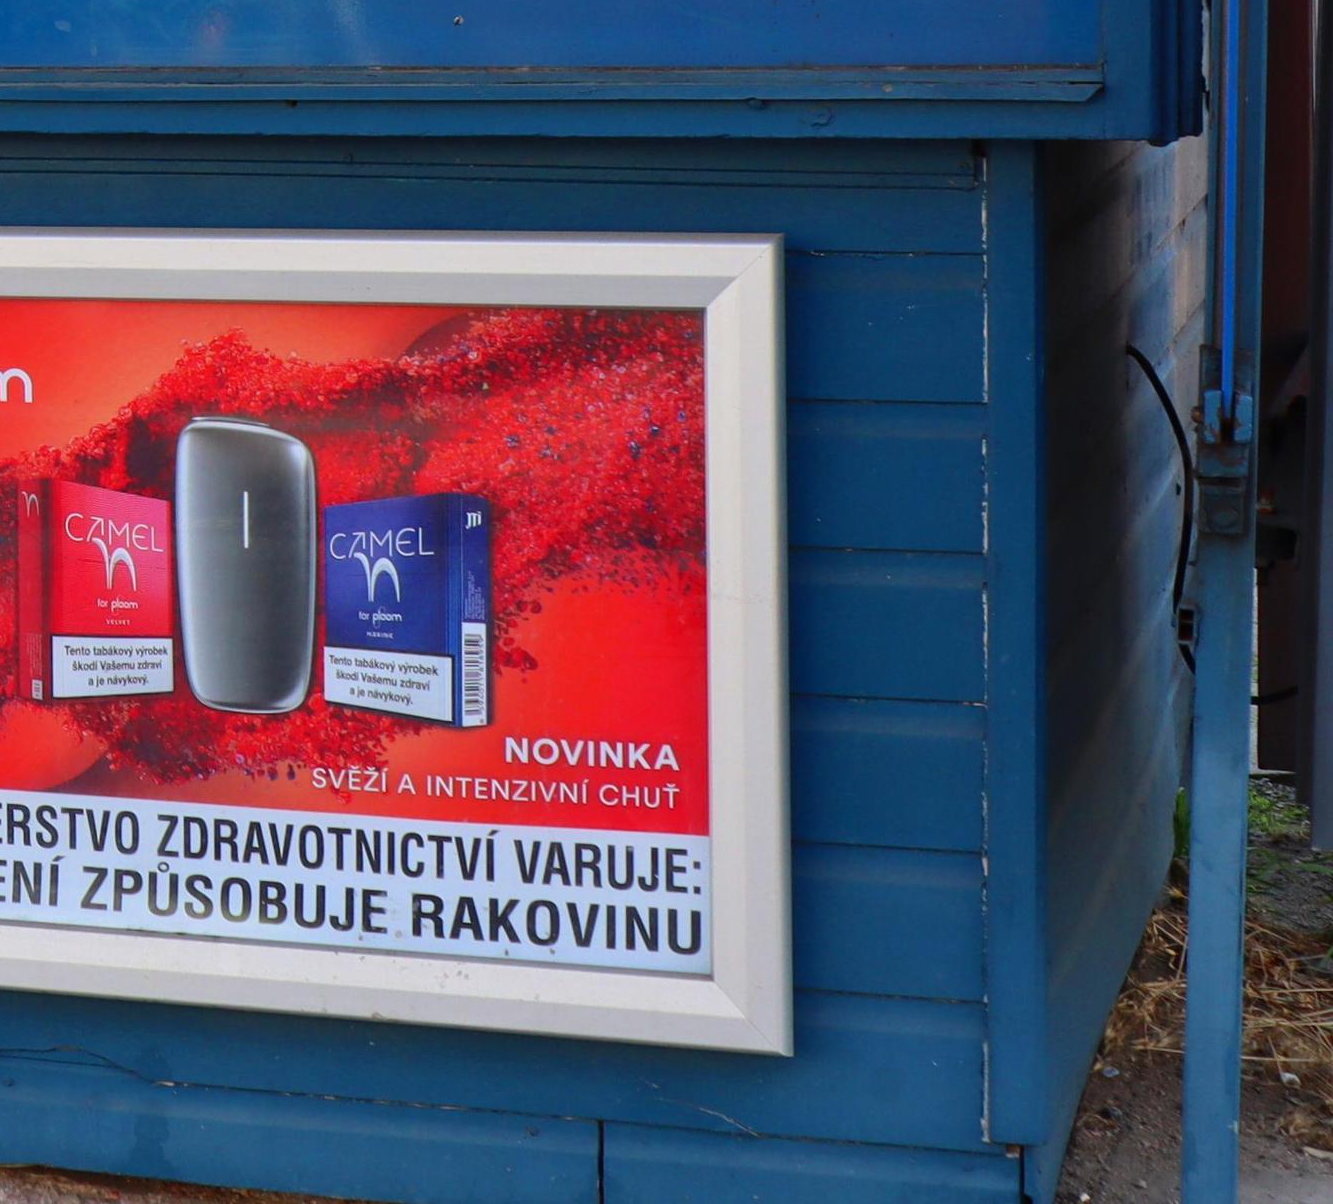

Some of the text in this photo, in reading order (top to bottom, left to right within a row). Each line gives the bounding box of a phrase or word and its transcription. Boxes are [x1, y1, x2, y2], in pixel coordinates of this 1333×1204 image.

[65, 513, 164, 553] CAMEL
[329, 527, 435, 560] CAMEL
[65, 645, 169, 657] Tento tabákový výrobek
[72, 659, 162, 672] škodí Vašemu zdraví
[329, 654, 439, 677] Tento tabákový výrobek
[96, 675, 104, 688] je
[107, 674, 150, 686] návykový.
[336, 669, 430, 692] škodí Vašemu zdraví
[357, 687, 367, 698] je
[368, 690, 414, 706] návykový.
[504, 737, 679, 772] NOVINKA
[312, 766, 681, 809] SVĚŽÍ A INTENZIVNÍ CHUŤ
[156, 813, 501, 883] ZDRAVOTNICTVÍ
[514, 839, 702, 895] VARUJE:
[80, 861, 388, 936] ZPŮSOBUJE
[411, 892, 703, 955] RAKOVINU
